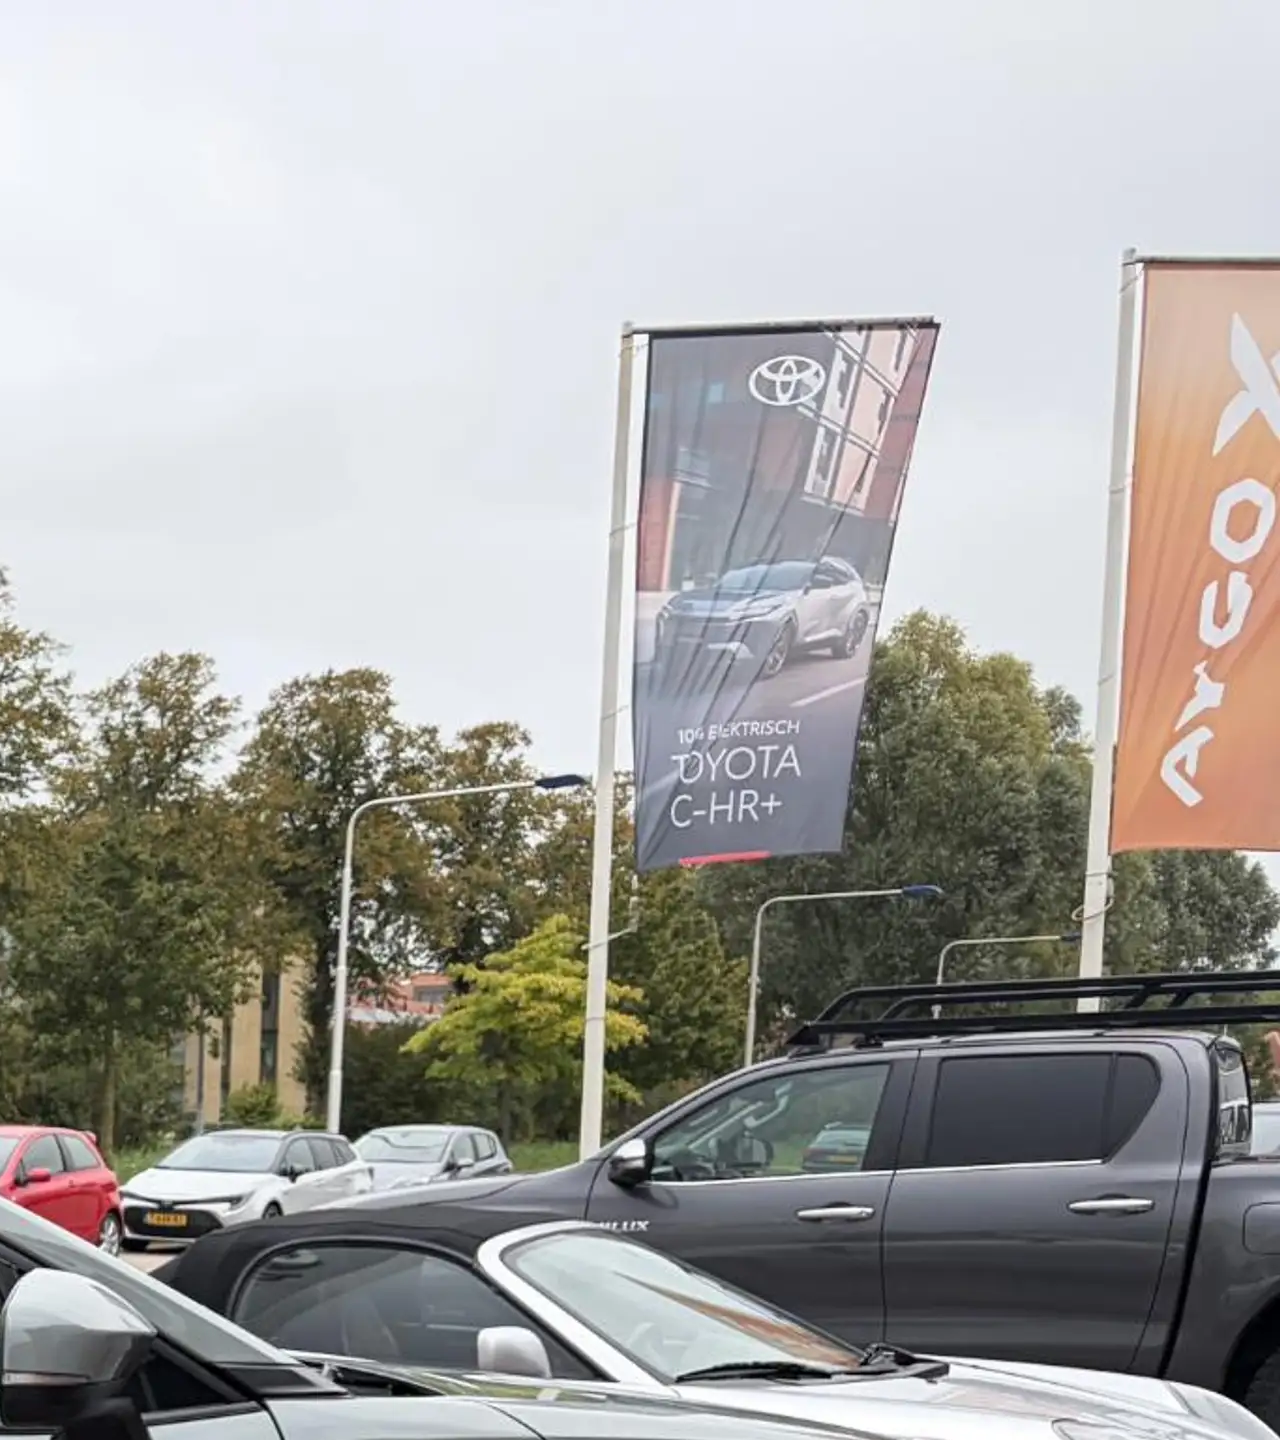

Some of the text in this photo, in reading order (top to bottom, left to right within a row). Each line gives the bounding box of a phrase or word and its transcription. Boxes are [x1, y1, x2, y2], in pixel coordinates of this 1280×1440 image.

[1160, 478, 1276, 808] AYGO
[670, 744, 801, 784] TOYOTA
[670, 789, 783, 828] C-HR+
